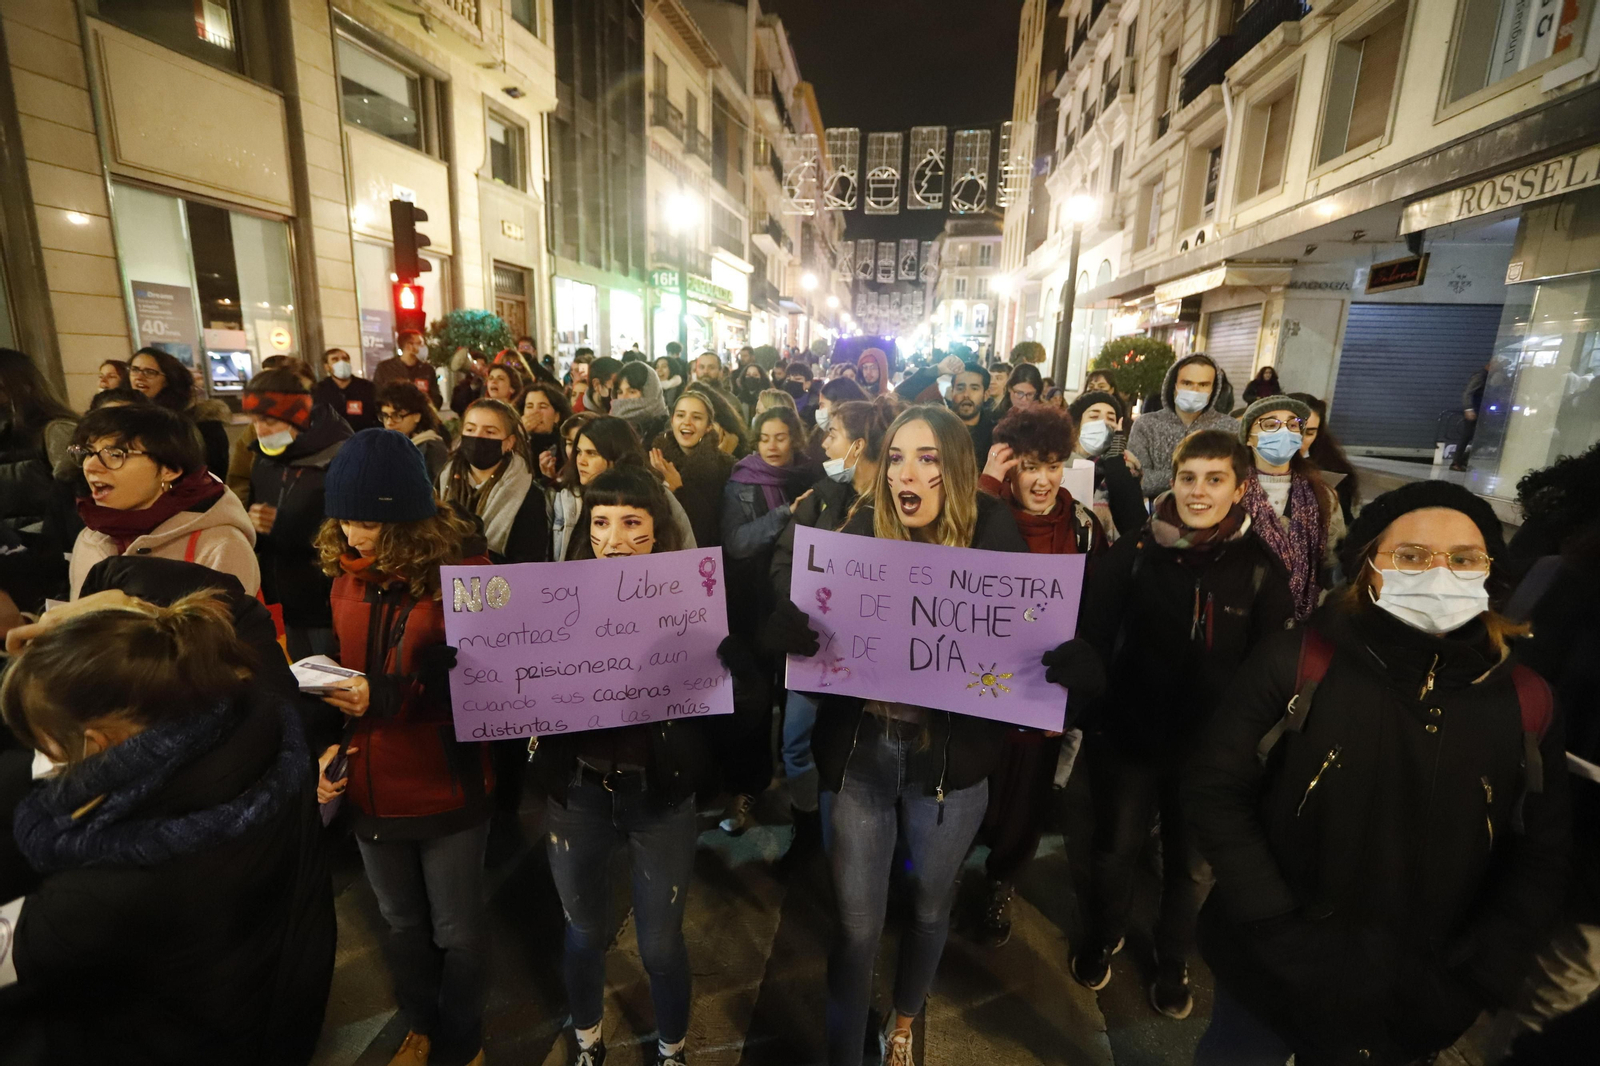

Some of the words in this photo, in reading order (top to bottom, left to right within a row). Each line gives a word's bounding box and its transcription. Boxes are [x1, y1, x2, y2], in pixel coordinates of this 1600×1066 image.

[652, 272, 679, 286] 16H
[807, 544, 835, 575] LA
[845, 559, 889, 581] CALLE
[909, 565, 933, 586] ES
[950, 569, 1064, 600] NUESTRA
[453, 576, 511, 612] NO
[541, 586, 580, 627] soy
[859, 593, 892, 622] DE
[911, 595, 1017, 638] NOCHE
[649, 650, 688, 666] aun
[821, 629, 837, 652] Y
[852, 634, 881, 663] DE
[910, 633, 967, 673] DÍA
[551, 691, 585, 704] sus
[593, 684, 671, 702] cadenas
[683, 675, 726, 691] sean
[472, 717, 569, 739] distintas
[587, 714, 604, 728] a
[666, 698, 710, 716] mías
